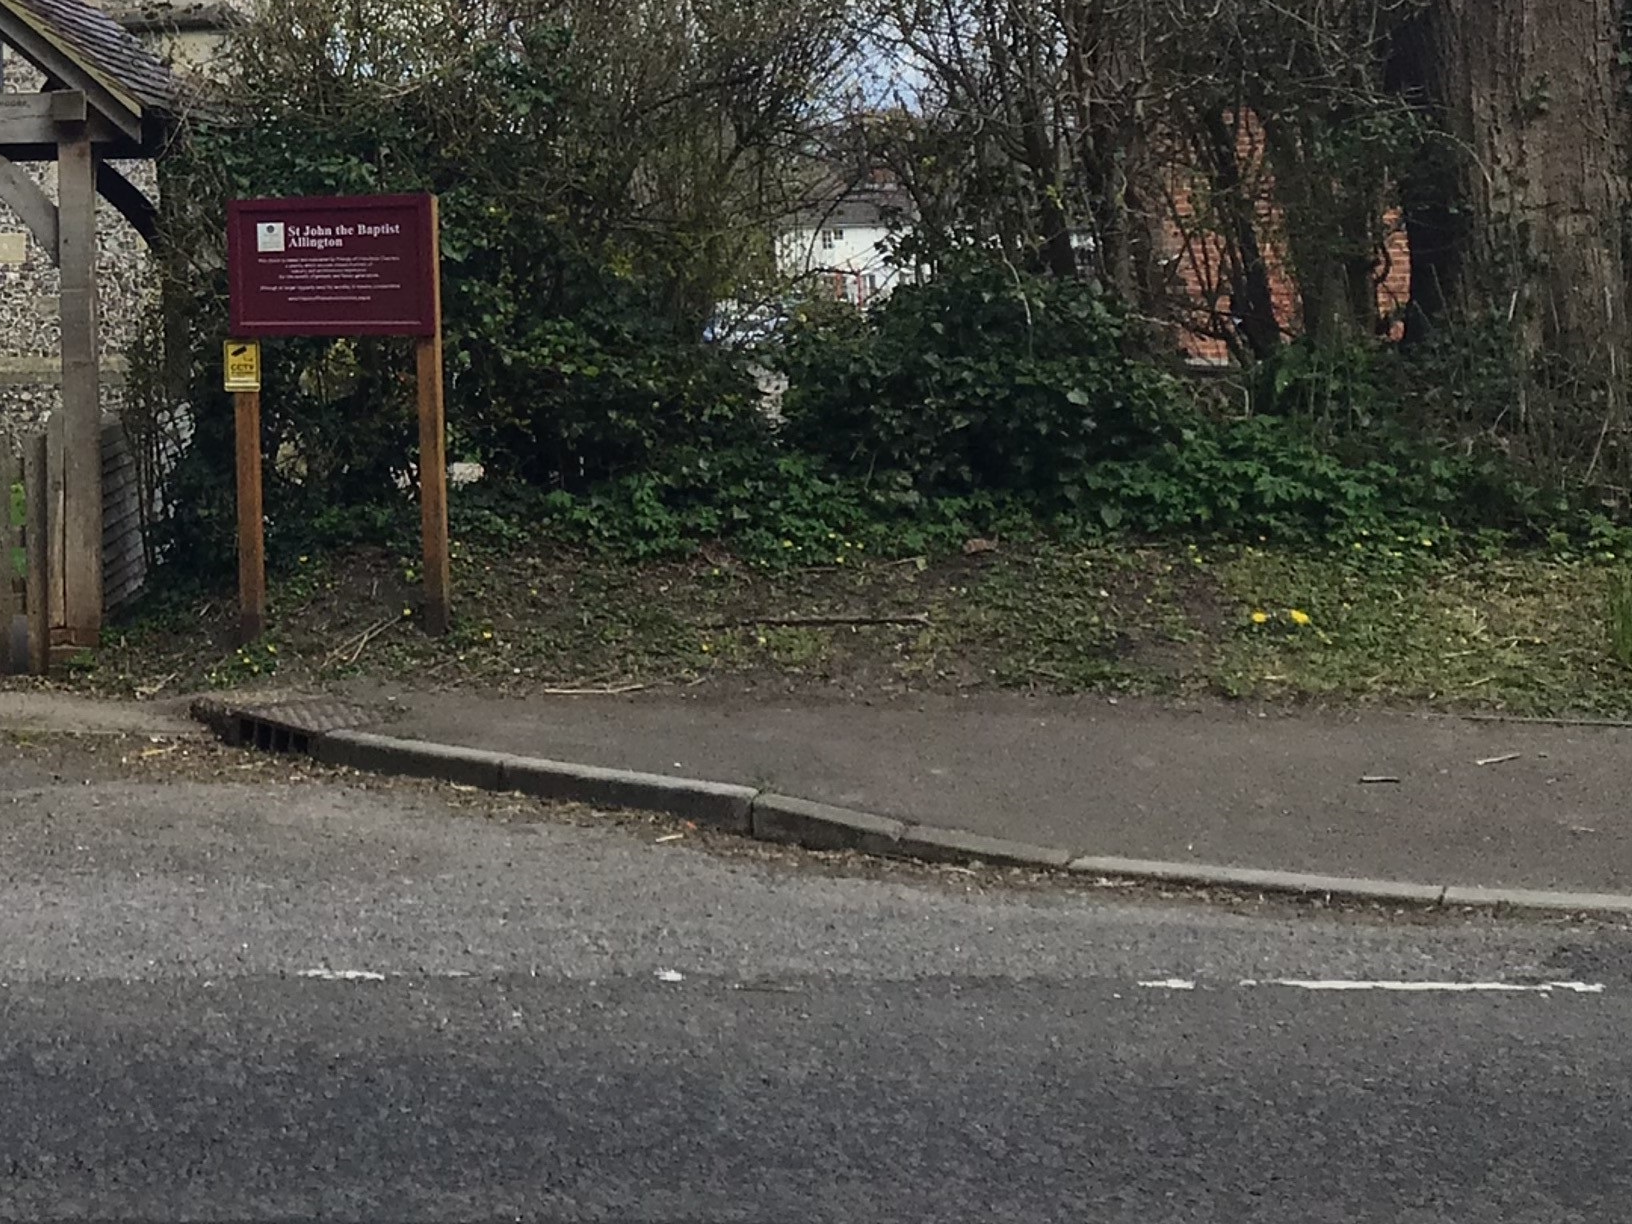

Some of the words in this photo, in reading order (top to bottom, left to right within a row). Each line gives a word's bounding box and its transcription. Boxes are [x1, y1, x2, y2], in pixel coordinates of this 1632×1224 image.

[288, 225, 300, 237] St
[303, 224, 332, 237] John
[335, 224, 354, 236] the
[357, 223, 400, 238] Baptist
[288, 237, 343, 250] Allington
[230, 363, 254, 372] CCTV
